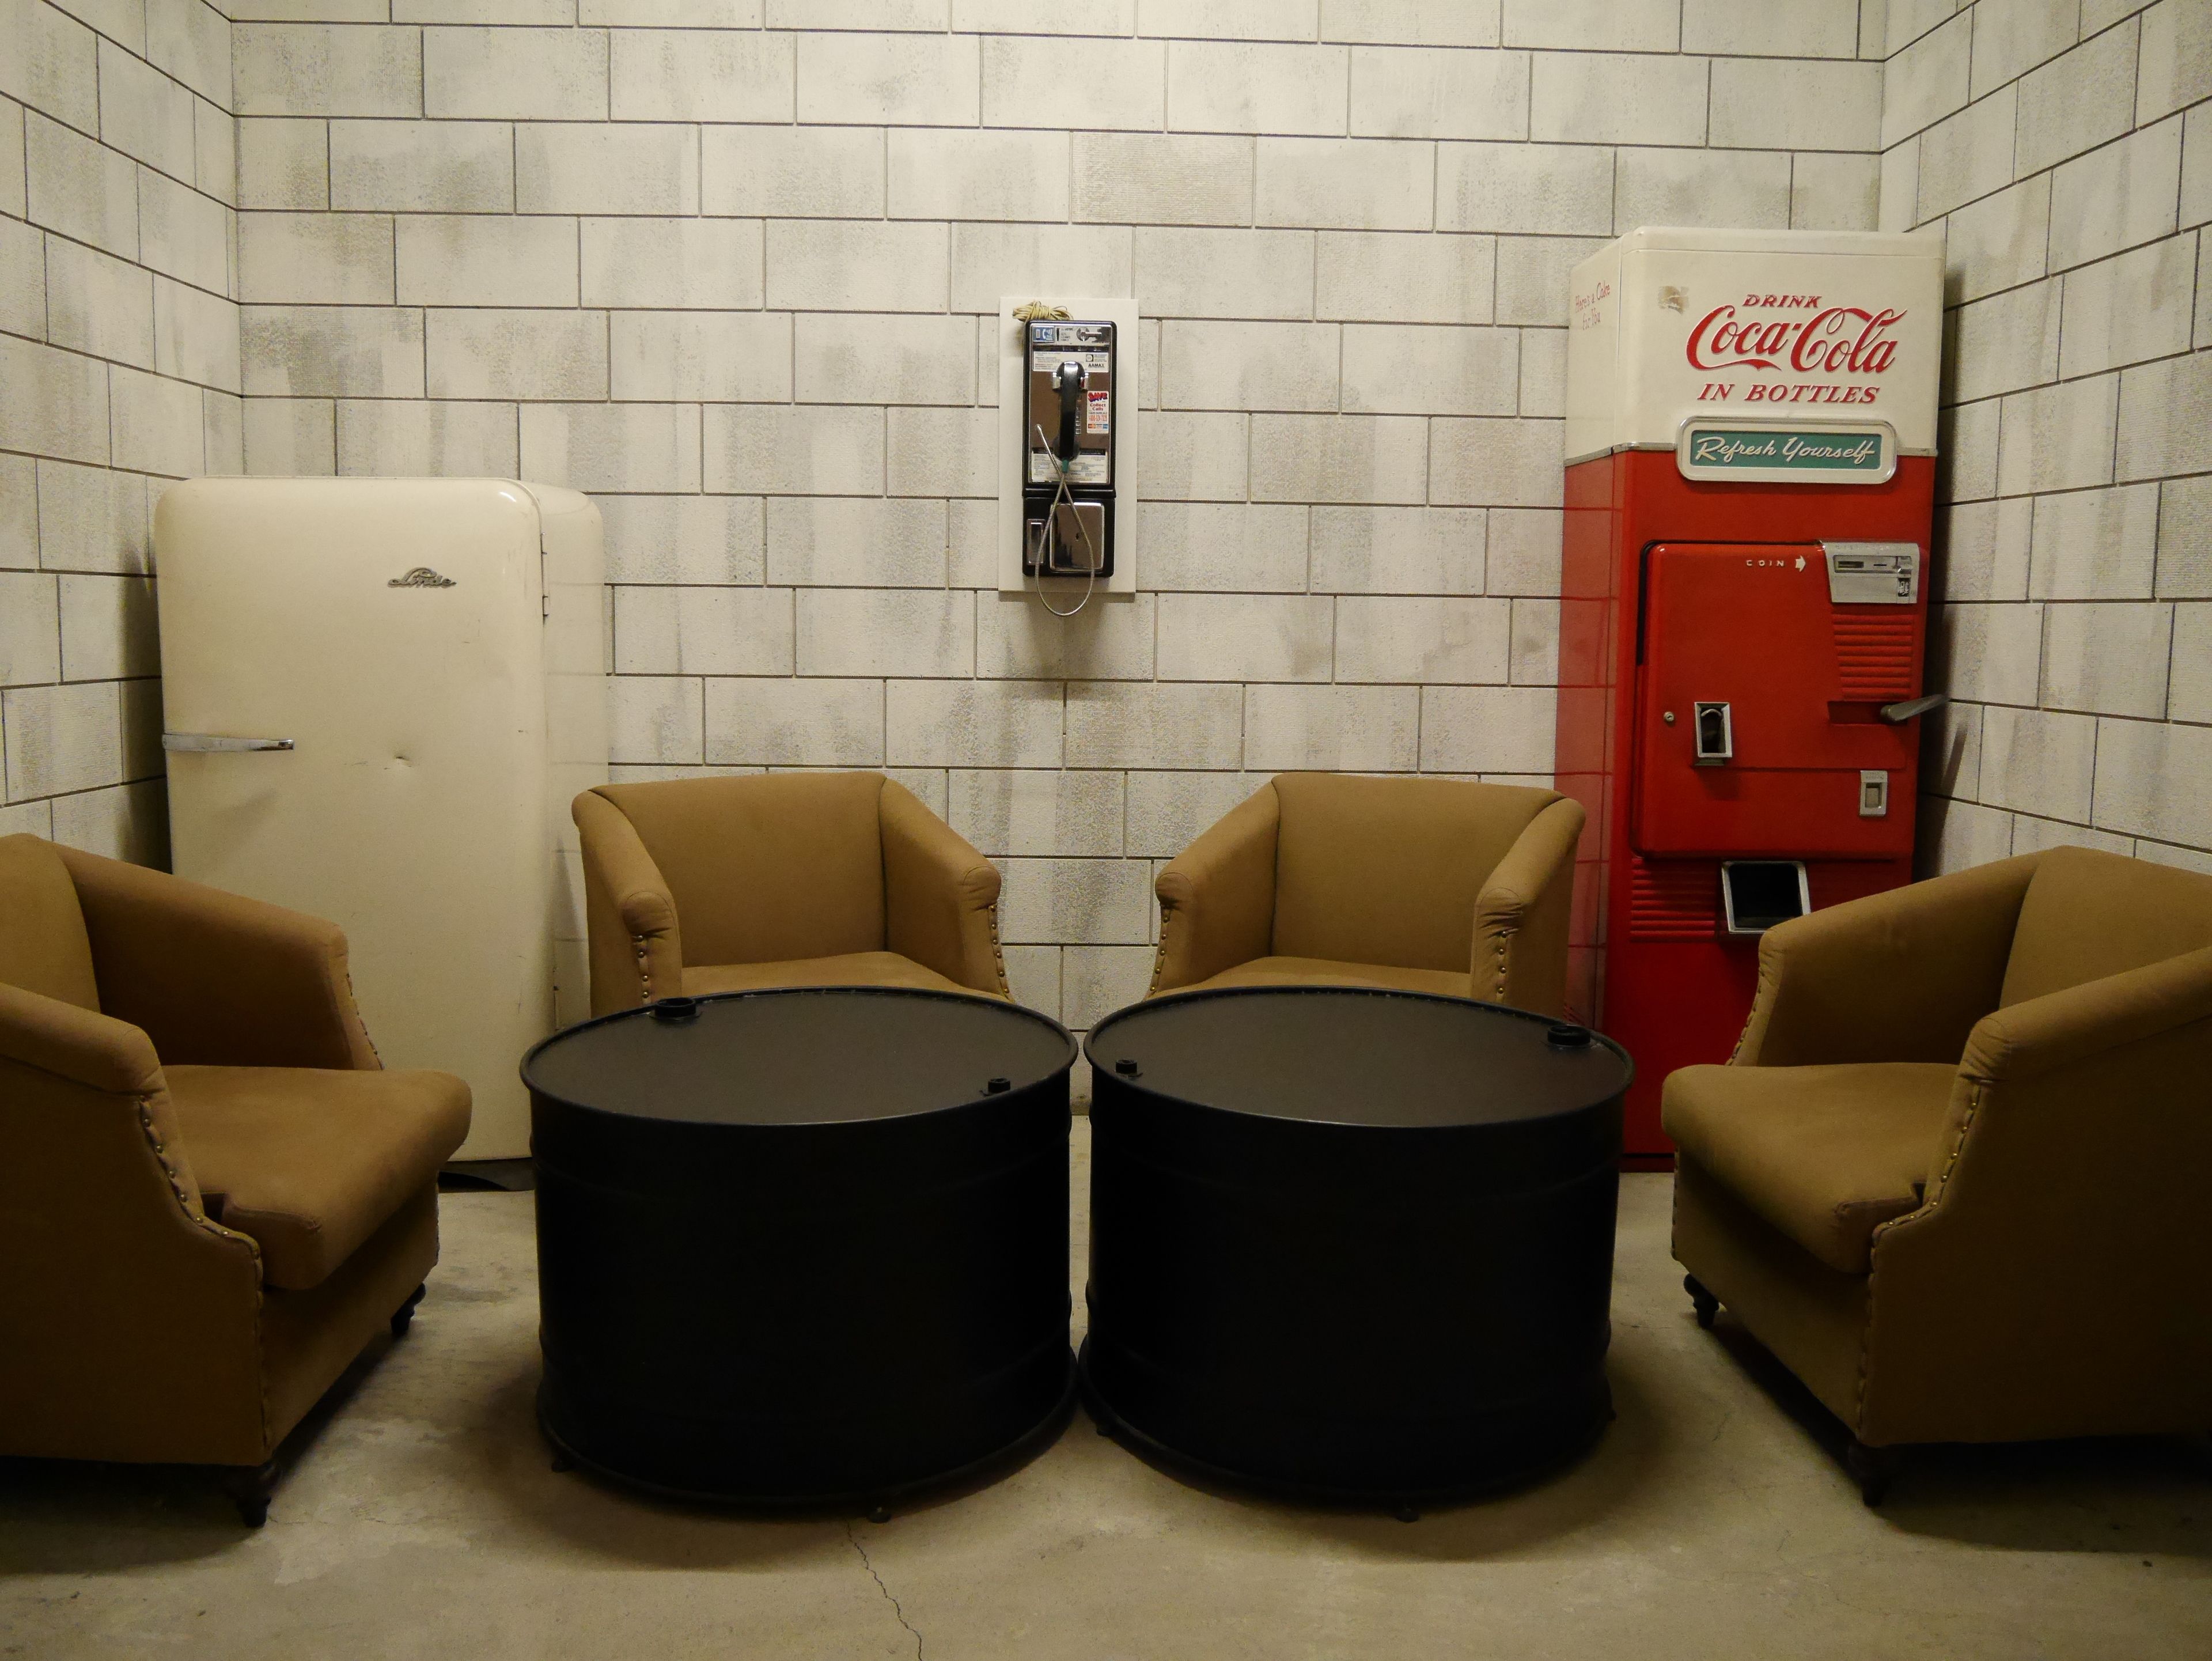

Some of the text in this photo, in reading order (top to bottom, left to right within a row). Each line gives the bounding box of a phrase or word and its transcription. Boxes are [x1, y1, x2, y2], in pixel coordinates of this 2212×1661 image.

[1596, 280, 1611, 300] Coke
[1742, 294, 1822, 308] DRINK
[1592, 307, 1601, 326] You
[1686, 304, 1908, 374] Coca-Cola
[1697, 383, 1880, 404] IN BOTTLES
[1695, 436, 1875, 464] Refresh Yourself
[388, 567, 457, 588] Linde
